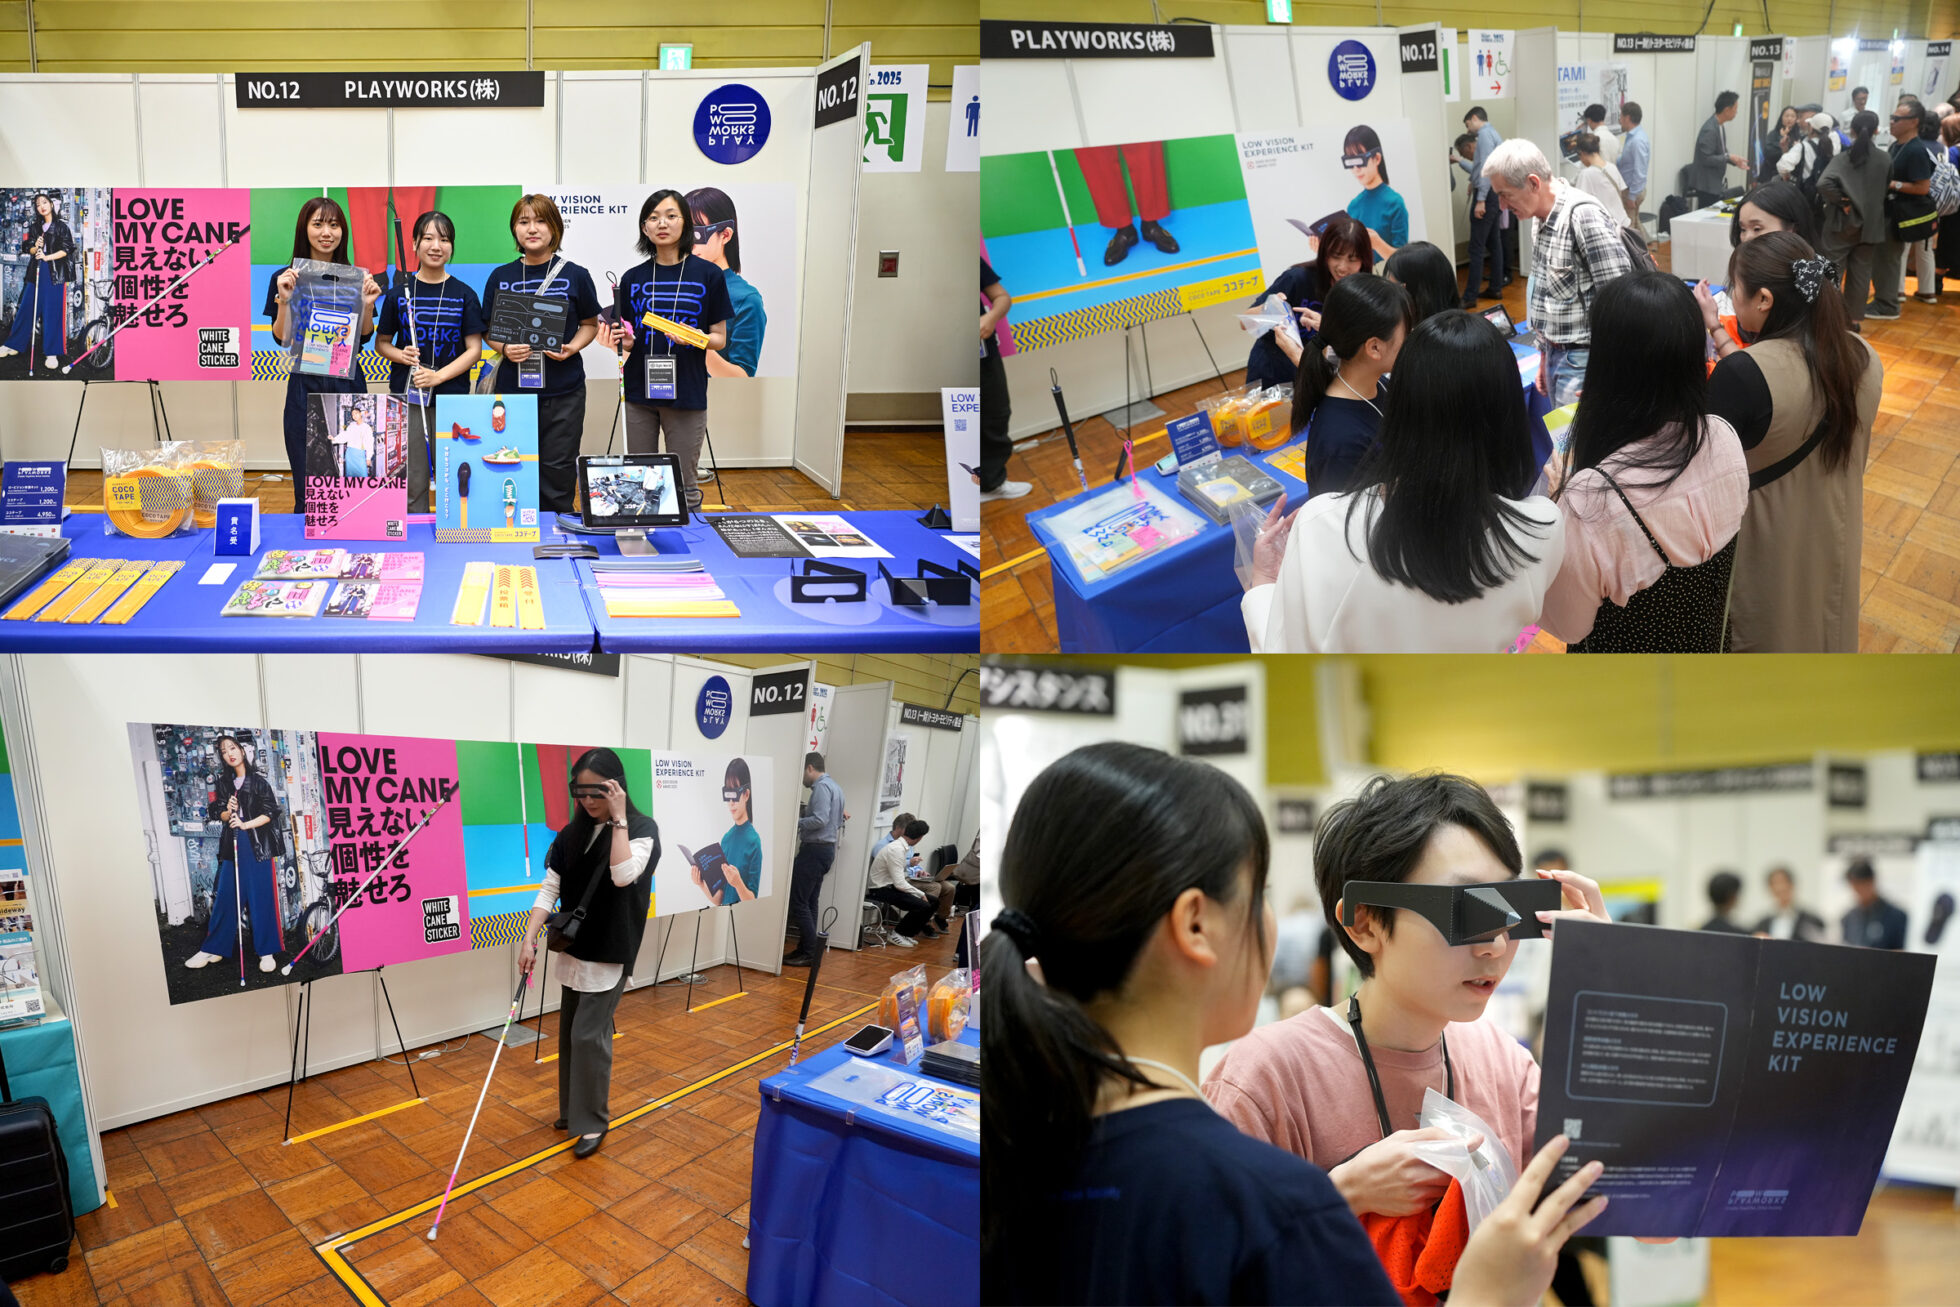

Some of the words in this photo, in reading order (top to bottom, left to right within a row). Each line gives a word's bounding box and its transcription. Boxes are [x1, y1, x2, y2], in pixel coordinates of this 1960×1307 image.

[1010, 29, 1176, 52] PLAYWORKS(株)
[1402, 42, 1437, 62] NO.12
[1751, 44, 1782, 57] NO.13
[877, 71, 902, 86] 2025
[248, 80, 301, 99] NO.12
[344, 79, 500, 102] PLAYWORKS(株)
[817, 76, 858, 112] NO.12
[1242, 140, 1263, 149] LOW
[1265, 137, 1295, 147] VISION
[1244, 145, 1299, 158] EXPERIENCE
[1301, 143, 1314, 151] KIT
[561, 195, 601, 204] VISION
[115, 198, 184, 220] LOVE
[609, 205, 628, 214] KIT
[115, 222, 162, 244] MY
[162, 221, 240, 244] CANE
[115, 246, 215, 270] 見えない
[114, 275, 190, 300] 個性を
[1224, 276, 1258, 293] ココテープ
[113, 302, 189, 329] 魅せろ
[200, 329, 228, 342] WHITE
[200, 343, 224, 354] CANE
[200, 355, 239, 367] STICKER
[951, 393, 975, 403] LOW
[112, 485, 135, 494] COCO
[306, 477, 340, 488] LOVE
[344, 477, 365, 488] MY
[366, 477, 406, 489] CANE
[114, 493, 135, 501] TAPE
[305, 488, 350, 500] 見えない
[305, 501, 339, 514] 個性を
[305, 515, 339, 527] 魅せろ
[753, 683, 804, 704] NO.12
[323, 745, 397, 775] LOVE
[655, 759, 670, 767] LOW
[672, 760, 692, 768] VISION
[655, 768, 694, 777] EXPERIENCE
[695, 769, 705, 777] KIT
[325, 778, 370, 804] MY
[374, 776, 452, 804] CANE
[328, 806, 431, 840] 見えない
[331, 842, 411, 875] 個性を
[334, 875, 412, 909] 魅せろ
[424, 900, 450, 914] WHITE
[425, 915, 446, 927] CANE
[426, 926, 459, 941] STICKER
[1780, 982, 1827, 1001] LOW
[1777, 1006, 1849, 1028] VISION
[1772, 1031, 1898, 1055] EXPERIENCE
[1768, 1055, 1802, 1073] KIT
